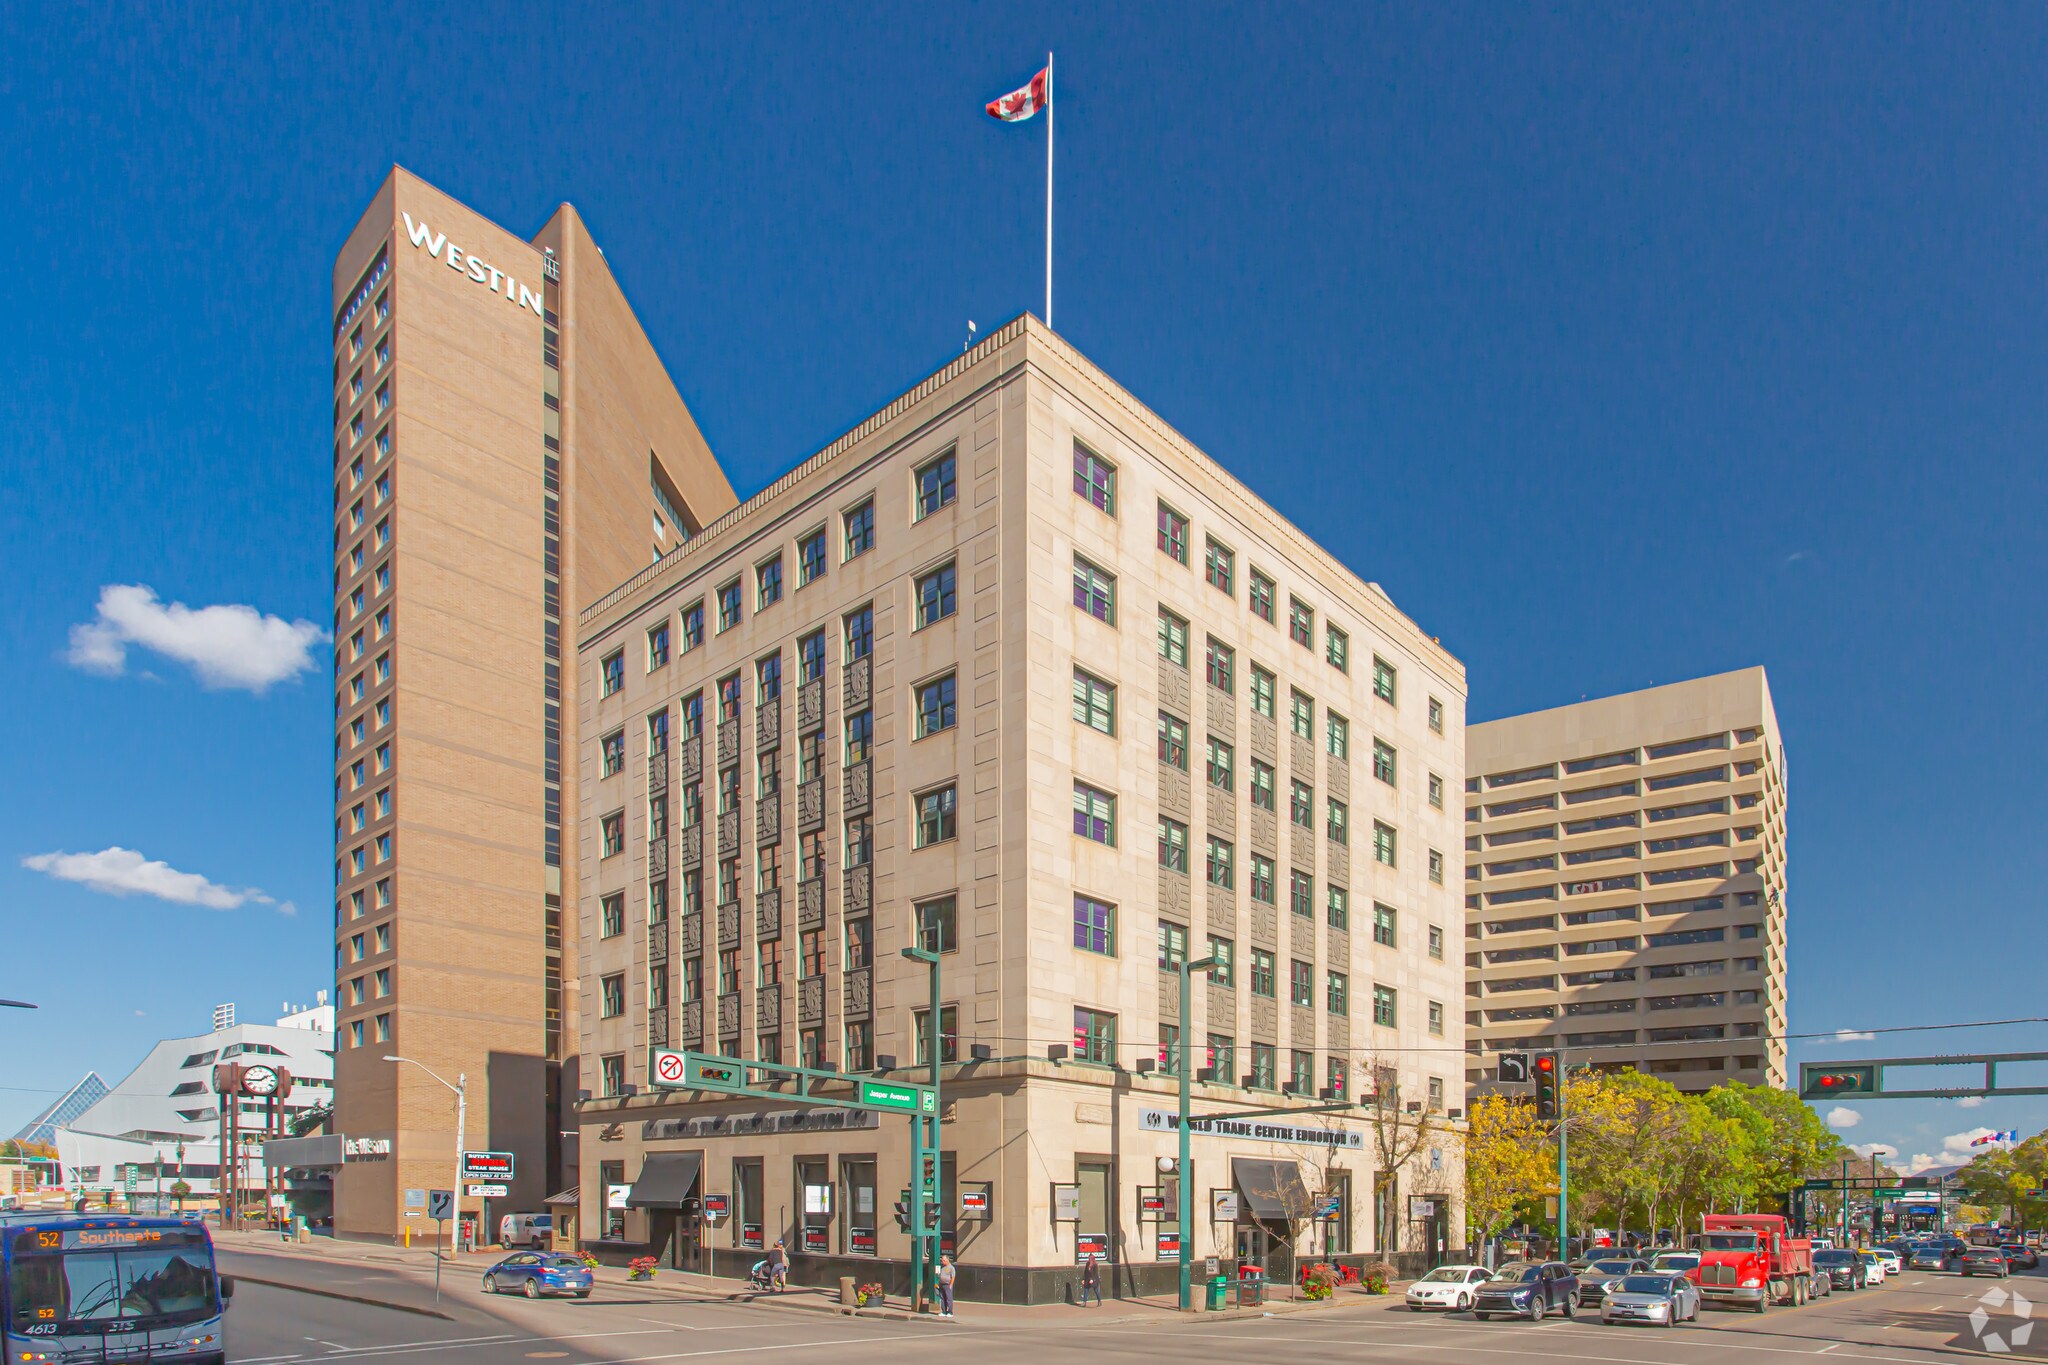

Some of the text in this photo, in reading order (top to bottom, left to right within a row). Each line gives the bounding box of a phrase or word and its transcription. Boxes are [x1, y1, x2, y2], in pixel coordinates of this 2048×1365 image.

[401, 211, 543, 316] WESTIN
[869, 1090, 911, 1102] Jasper Avenue
[1216, 1120, 1251, 1137] TRADE
[1255, 1124, 1293, 1141] CENTRE
[1296, 1129, 1347, 1146] EDMONTON
[38, 1229, 161, 1248] 52 Southgate
[38, 1308, 55, 1319] 52
[25, 1323, 58, 1335] 4613
